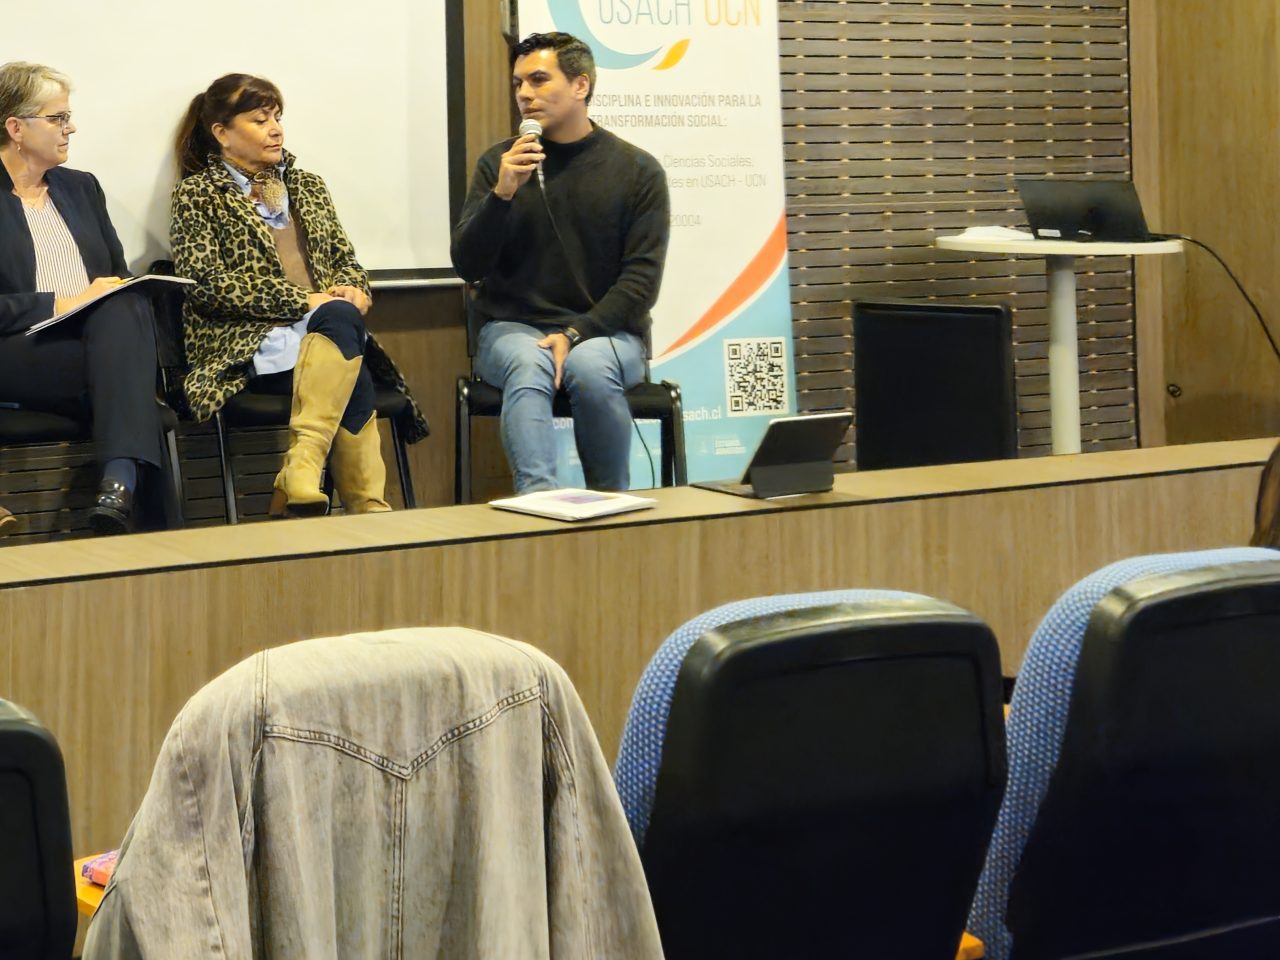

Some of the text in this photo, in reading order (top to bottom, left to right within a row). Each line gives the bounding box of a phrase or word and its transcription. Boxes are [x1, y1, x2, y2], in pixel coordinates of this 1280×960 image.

[645, 94, 651, 107] E
[653, 91, 715, 108] INNOVACIÓN
[718, 94, 746, 107] PARA
[748, 94, 762, 107] LA
[663, 154, 706, 168] Ciencias
[701, 174, 736, 188] USACH
